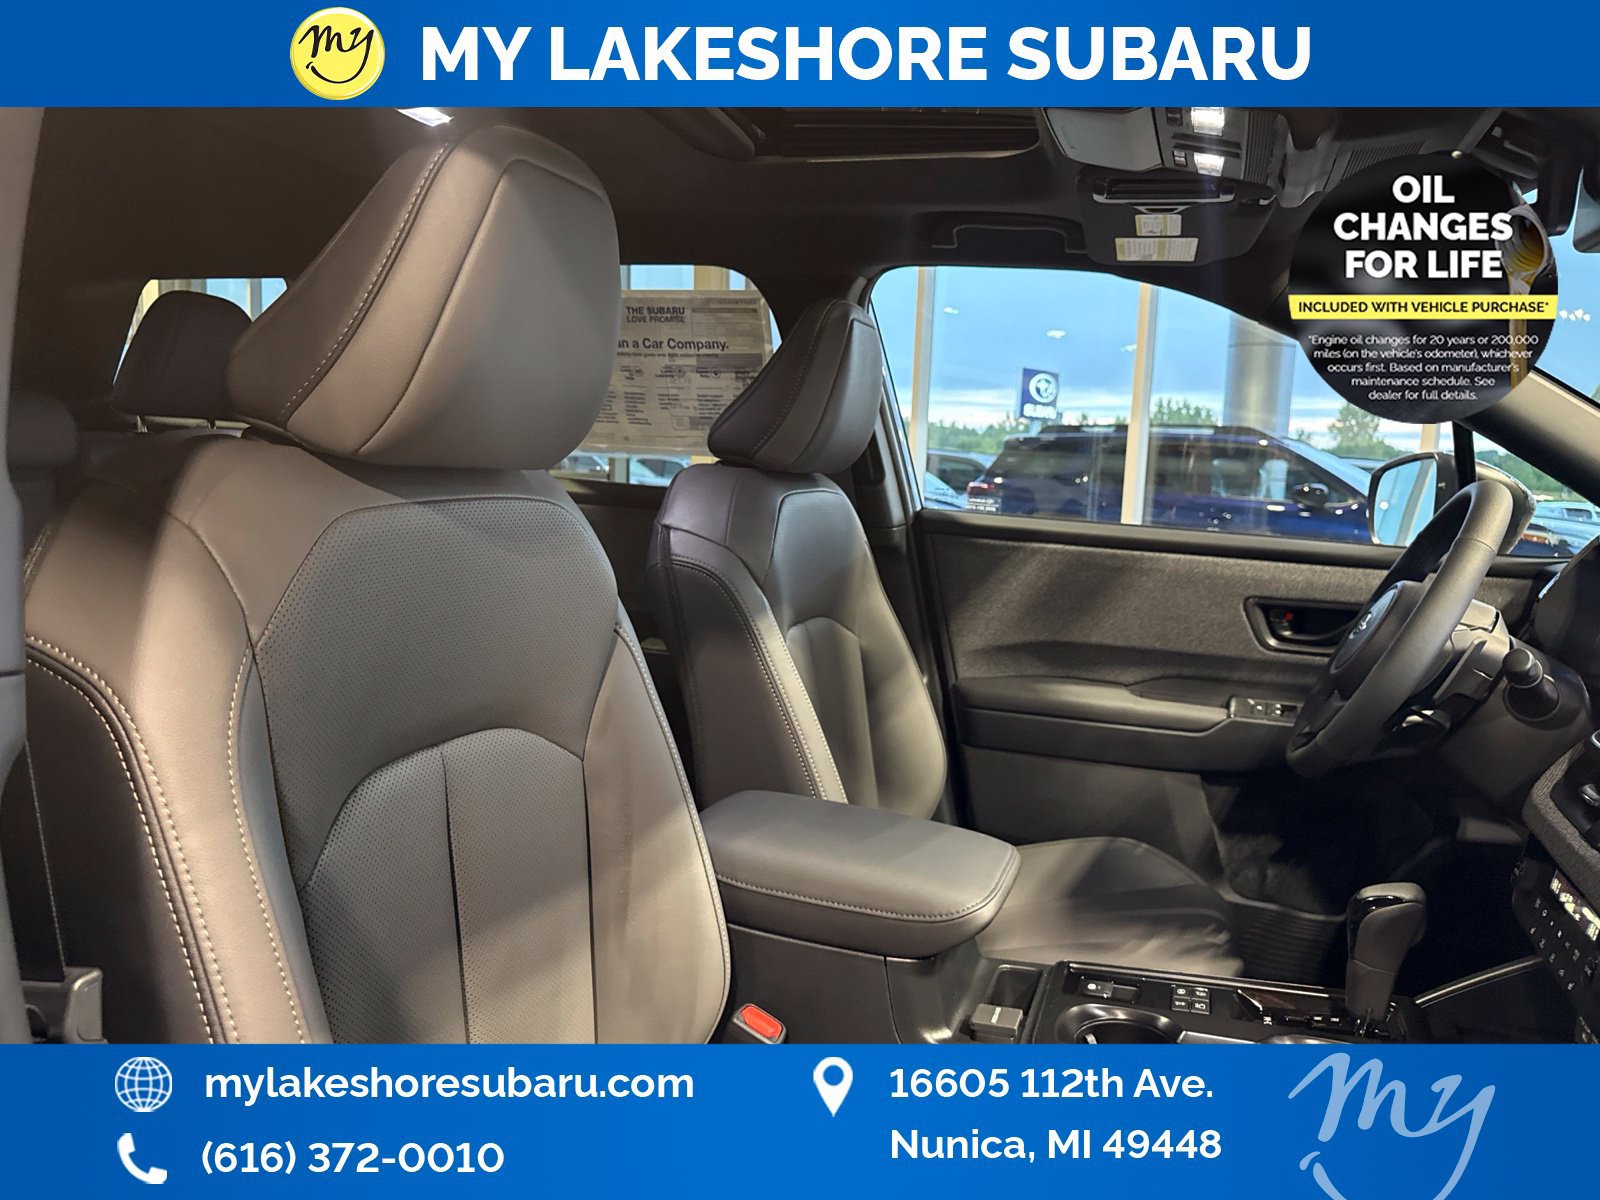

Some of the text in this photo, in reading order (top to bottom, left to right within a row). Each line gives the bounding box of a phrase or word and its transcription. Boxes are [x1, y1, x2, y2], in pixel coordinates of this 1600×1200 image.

[626, 307, 685, 316] THE SUBARU
[649, 316, 686, 324] PROMISE
[632, 341, 640, 349] a
[642, 338, 664, 350] Car
[667, 338, 729, 352] Company.
